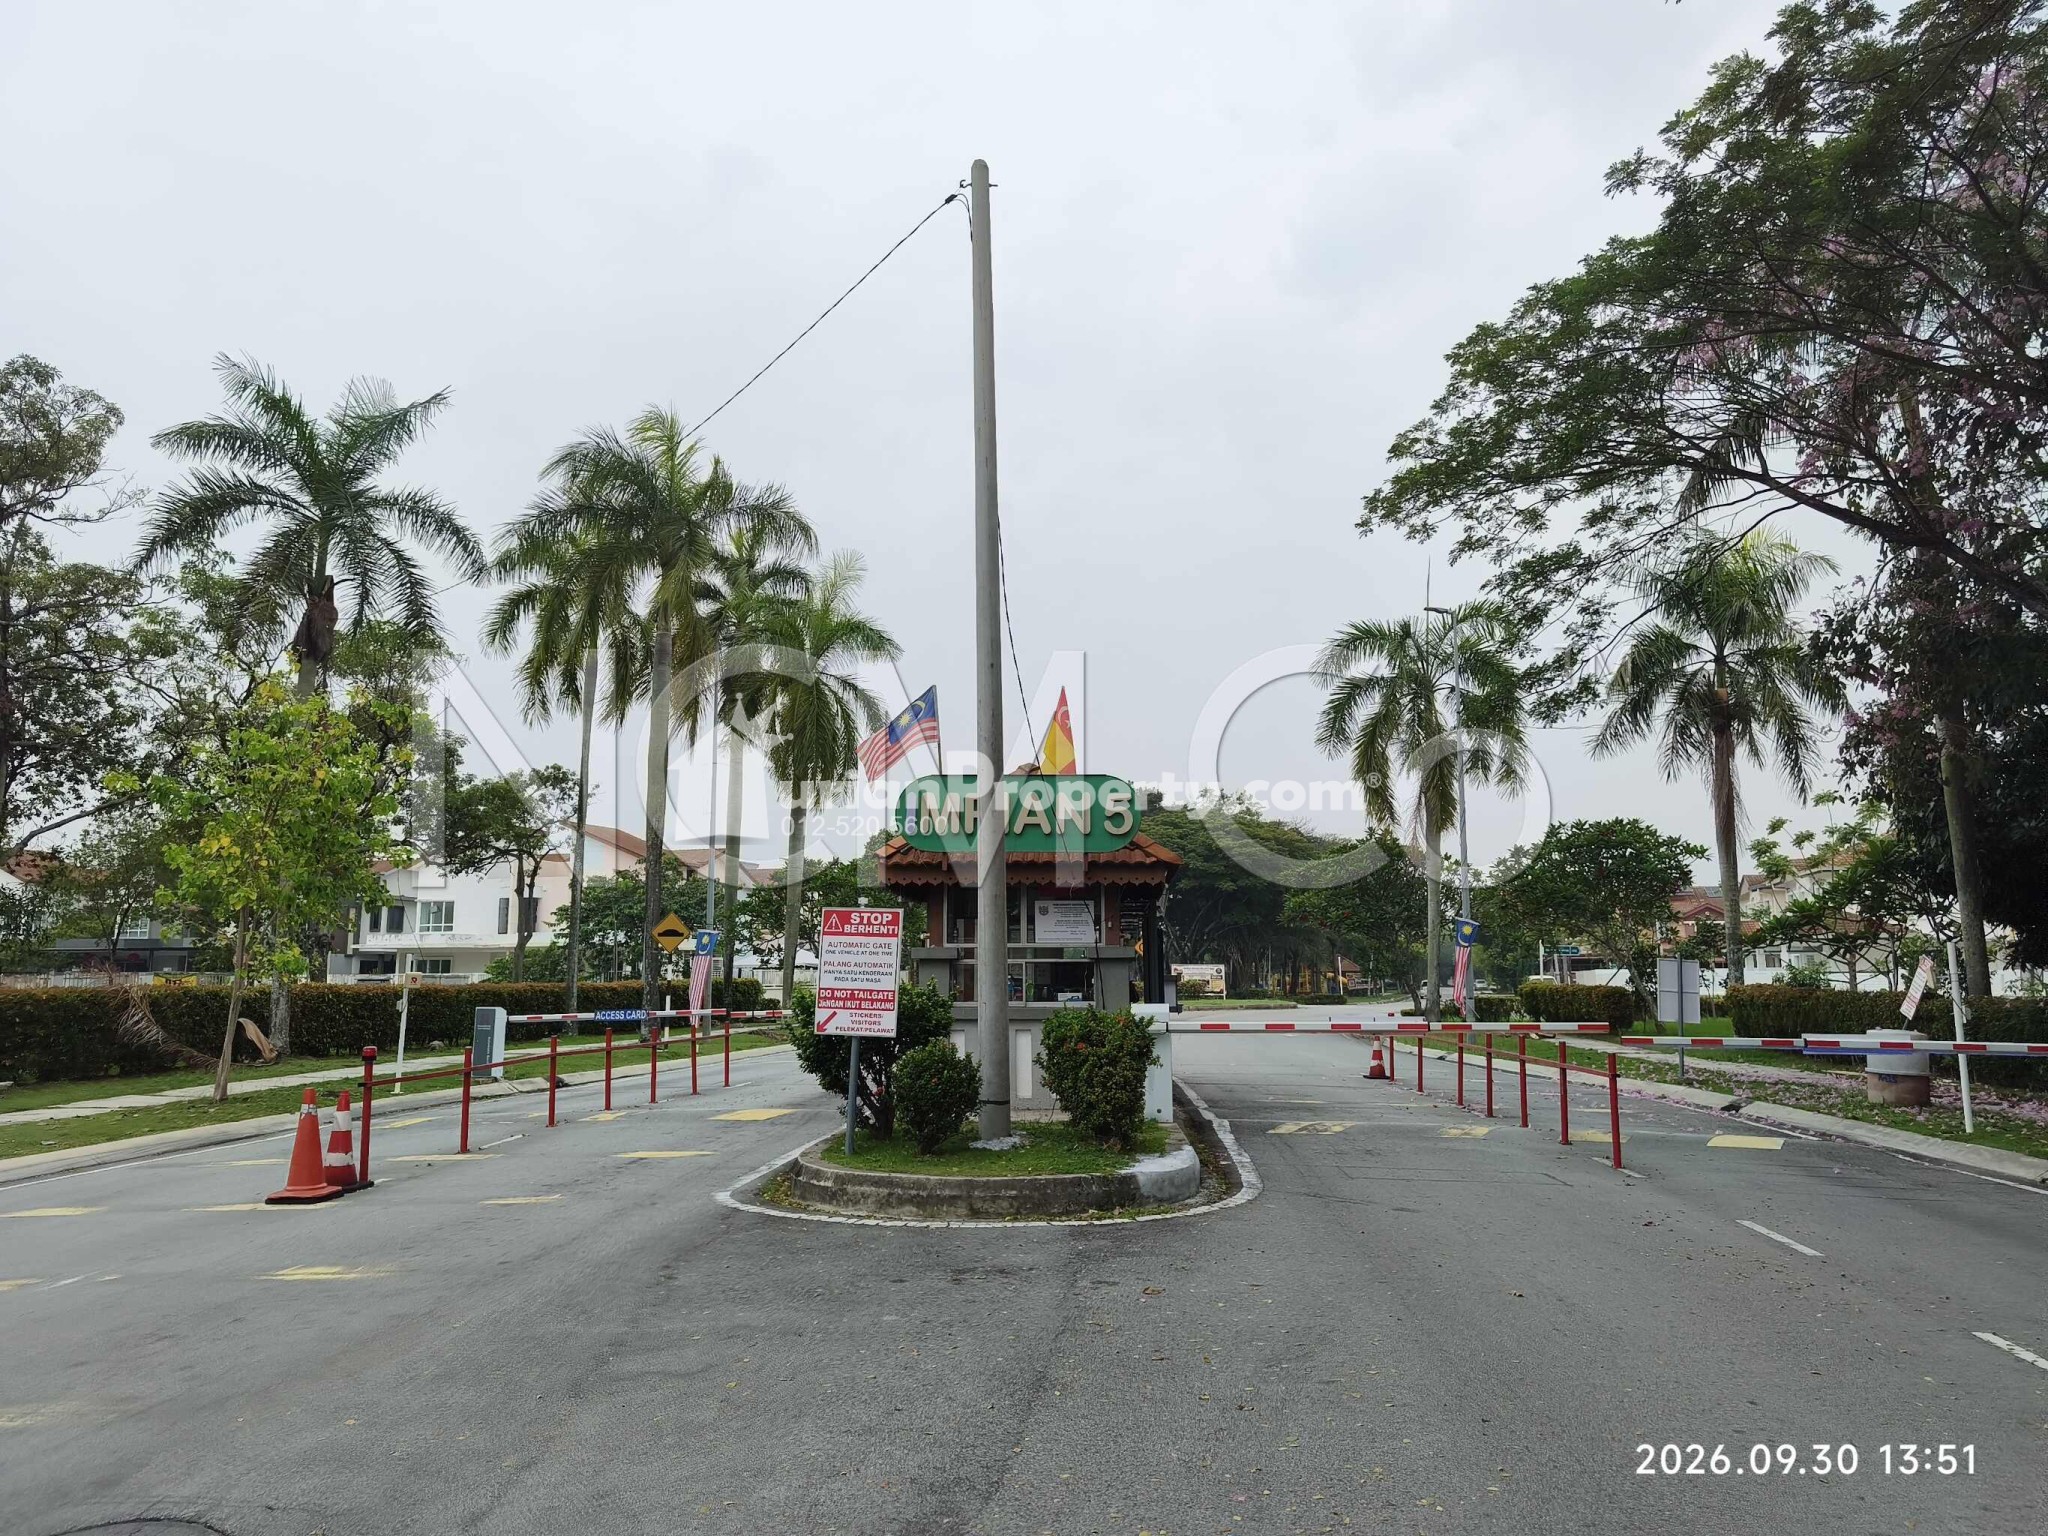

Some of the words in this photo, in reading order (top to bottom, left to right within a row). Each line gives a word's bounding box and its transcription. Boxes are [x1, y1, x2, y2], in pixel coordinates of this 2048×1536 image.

[1103, 793, 1134, 835] 5
[850, 912, 893, 925] STOP
[843, 924, 898, 935] BERHENTI
[828, 941, 871, 949] AUTOMATIC
[872, 942, 893, 950] GATE
[823, 960, 852, 968] PALANG
[853, 961, 894, 969] AUTOMATIK
[820, 989, 832, 998] DO
[834, 989, 852, 998] NOT
[853, 990, 894, 1000] TAILGATE
[818, 999, 844, 1008] JANGAN
[844, 1000, 860, 1009] IKUT
[861, 1000, 894, 1010] BELAKANG
[595, 1010, 625, 1020] ACCESS
[625, 1009, 647, 1020] CARD
